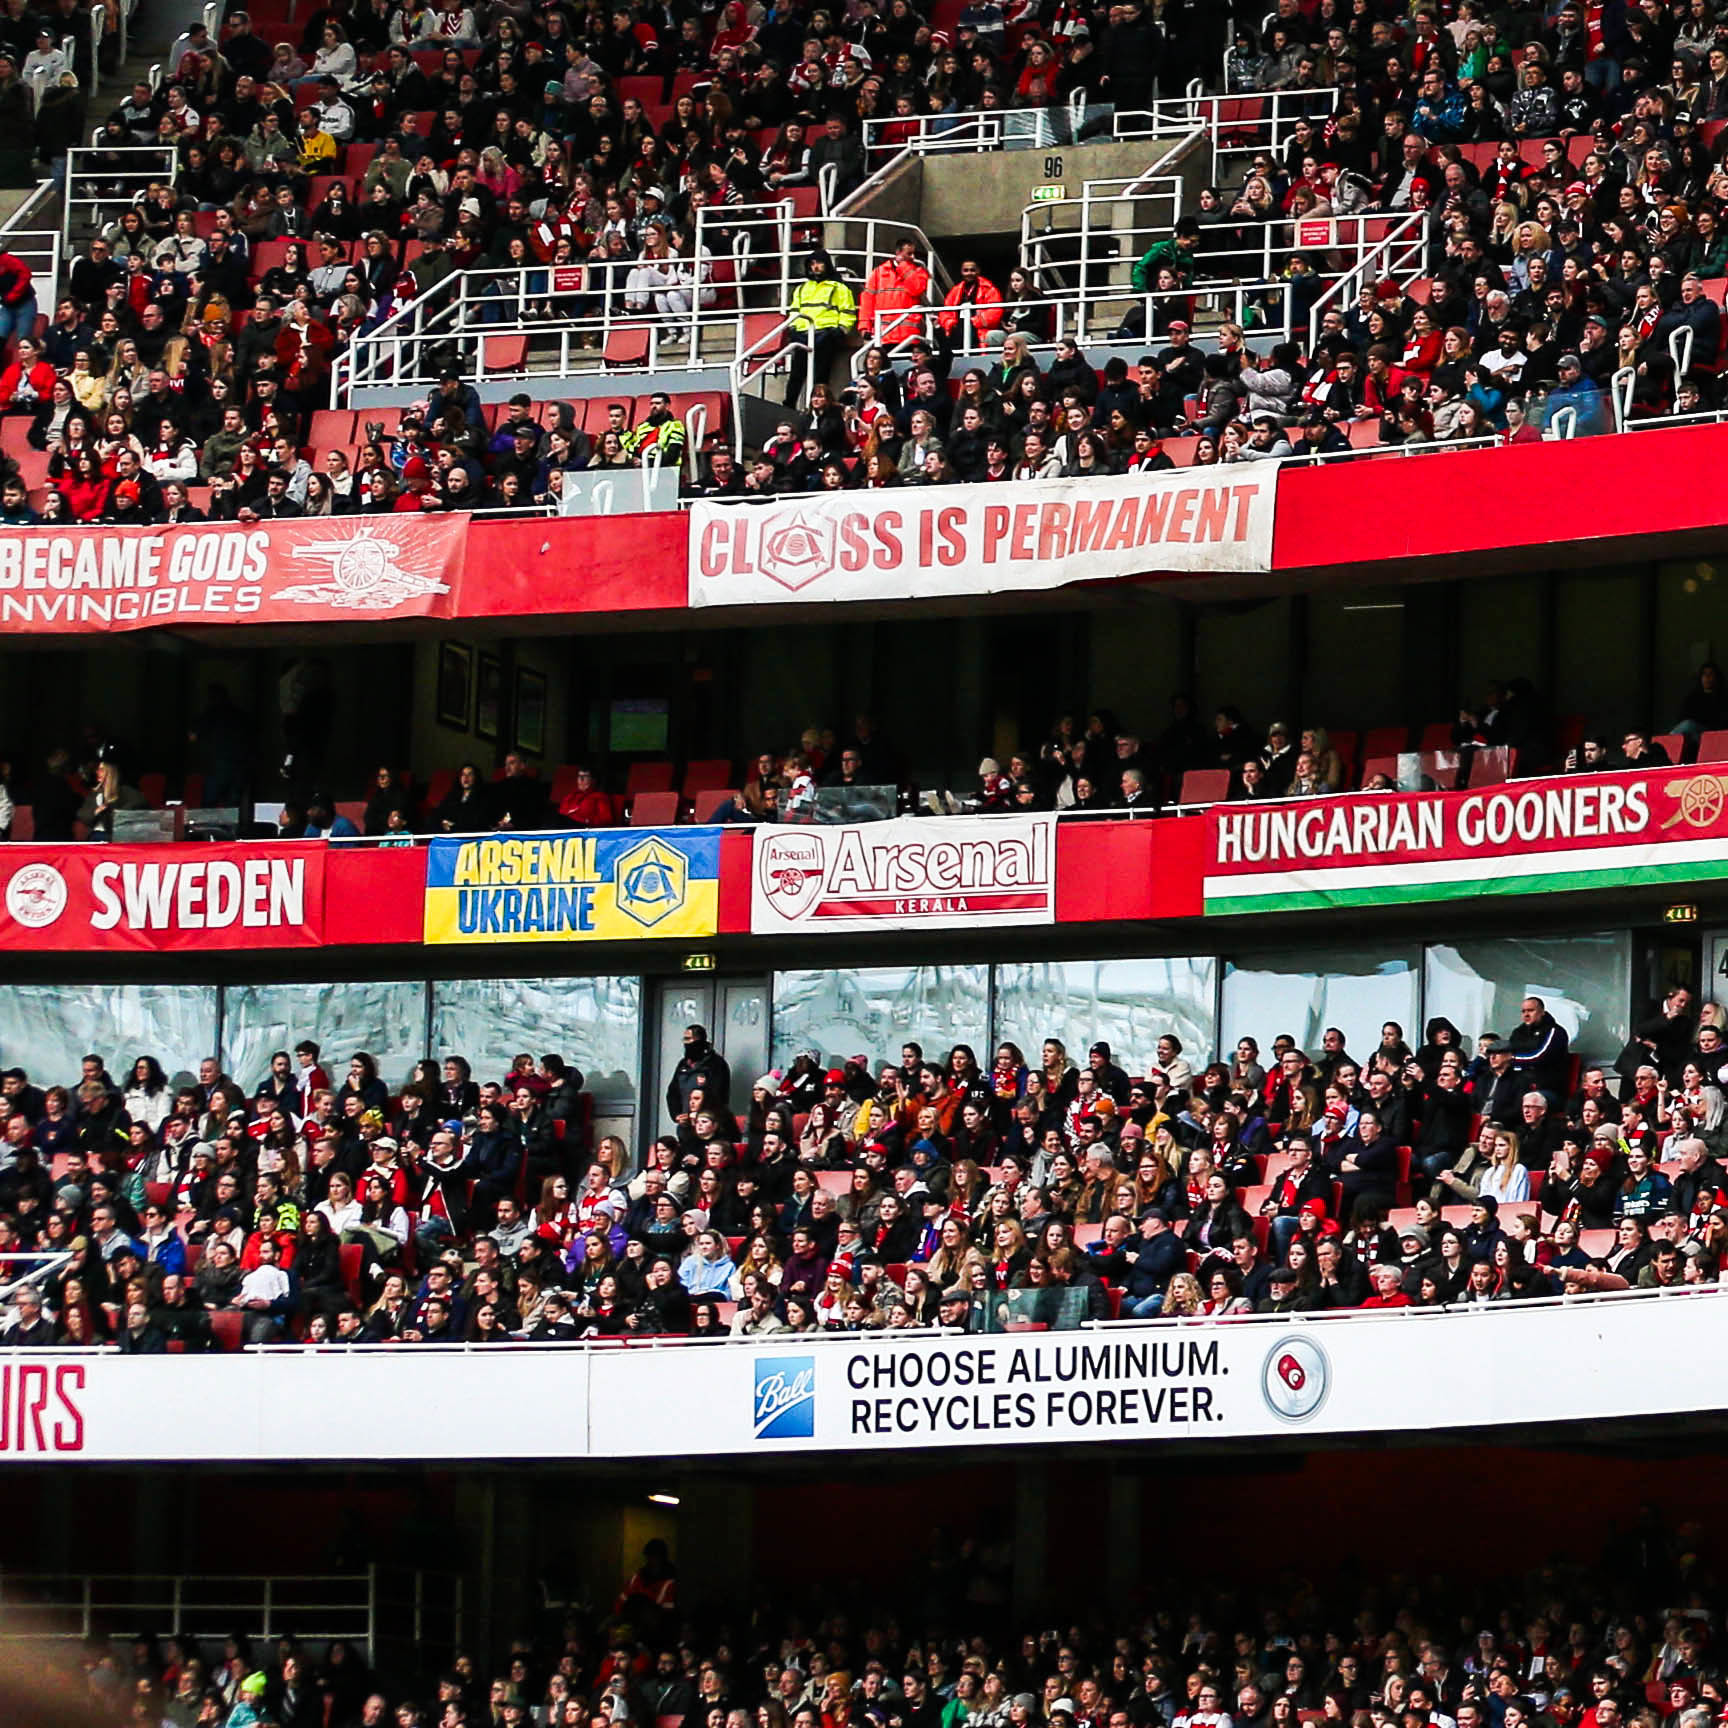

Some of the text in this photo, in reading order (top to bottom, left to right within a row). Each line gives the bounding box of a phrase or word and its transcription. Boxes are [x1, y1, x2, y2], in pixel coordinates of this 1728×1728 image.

[1044, 156, 1063, 178] 96
[918, 507, 967, 567] IS
[982, 483, 1259, 564] PERMANENT
[0, 530, 270, 589] BECAME GODS
[1217, 782, 1650, 863] HUNGARIAN GOONERS
[454, 836, 602, 886] ARSENAL
[770, 847, 815, 861] Arsenal
[827, 822, 1048, 892] Arsenal
[90, 858, 305, 931] SWEDEN
[458, 886, 595, 934] UKRAINE
[896, 897, 968, 913] KERALA
[846, 1340, 1231, 1390] CHOOSE ALUMINIUM.
[756, 1369, 814, 1414] Ball
[850, 1385, 1224, 1434] RECYCLES FOREVER.
